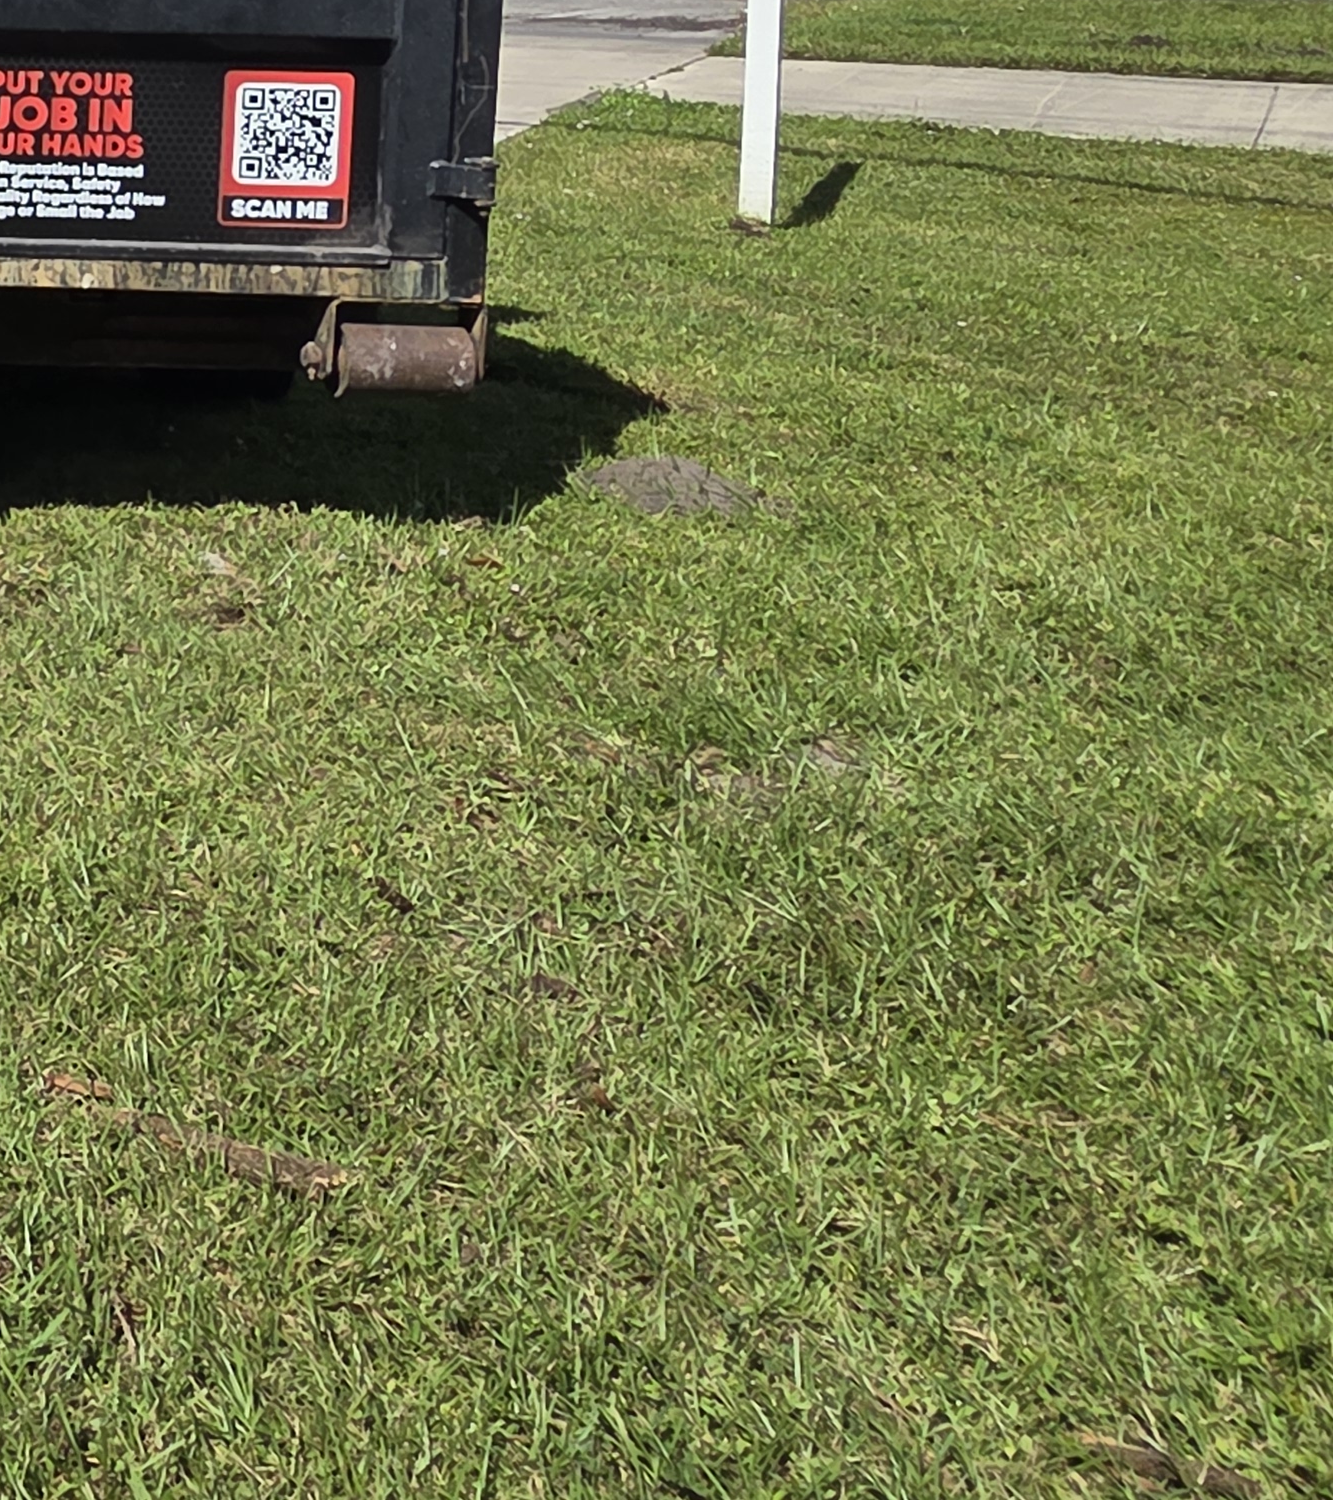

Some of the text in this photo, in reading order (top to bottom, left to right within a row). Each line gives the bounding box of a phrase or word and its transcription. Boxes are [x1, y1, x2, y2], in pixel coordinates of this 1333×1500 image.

[49, 71, 133, 96] YOUR
[88, 98, 133, 133] IN
[42, 133, 144, 159] HANDS
[0, 160, 80, 176] Reputation
[97, 163, 144, 178] Based
[11, 176, 69, 191] Service,
[72, 178, 121, 193] Safety
[132, 193, 166, 206] How
[106, 206, 135, 220] Job
[231, 199, 329, 220] SCAN ME
